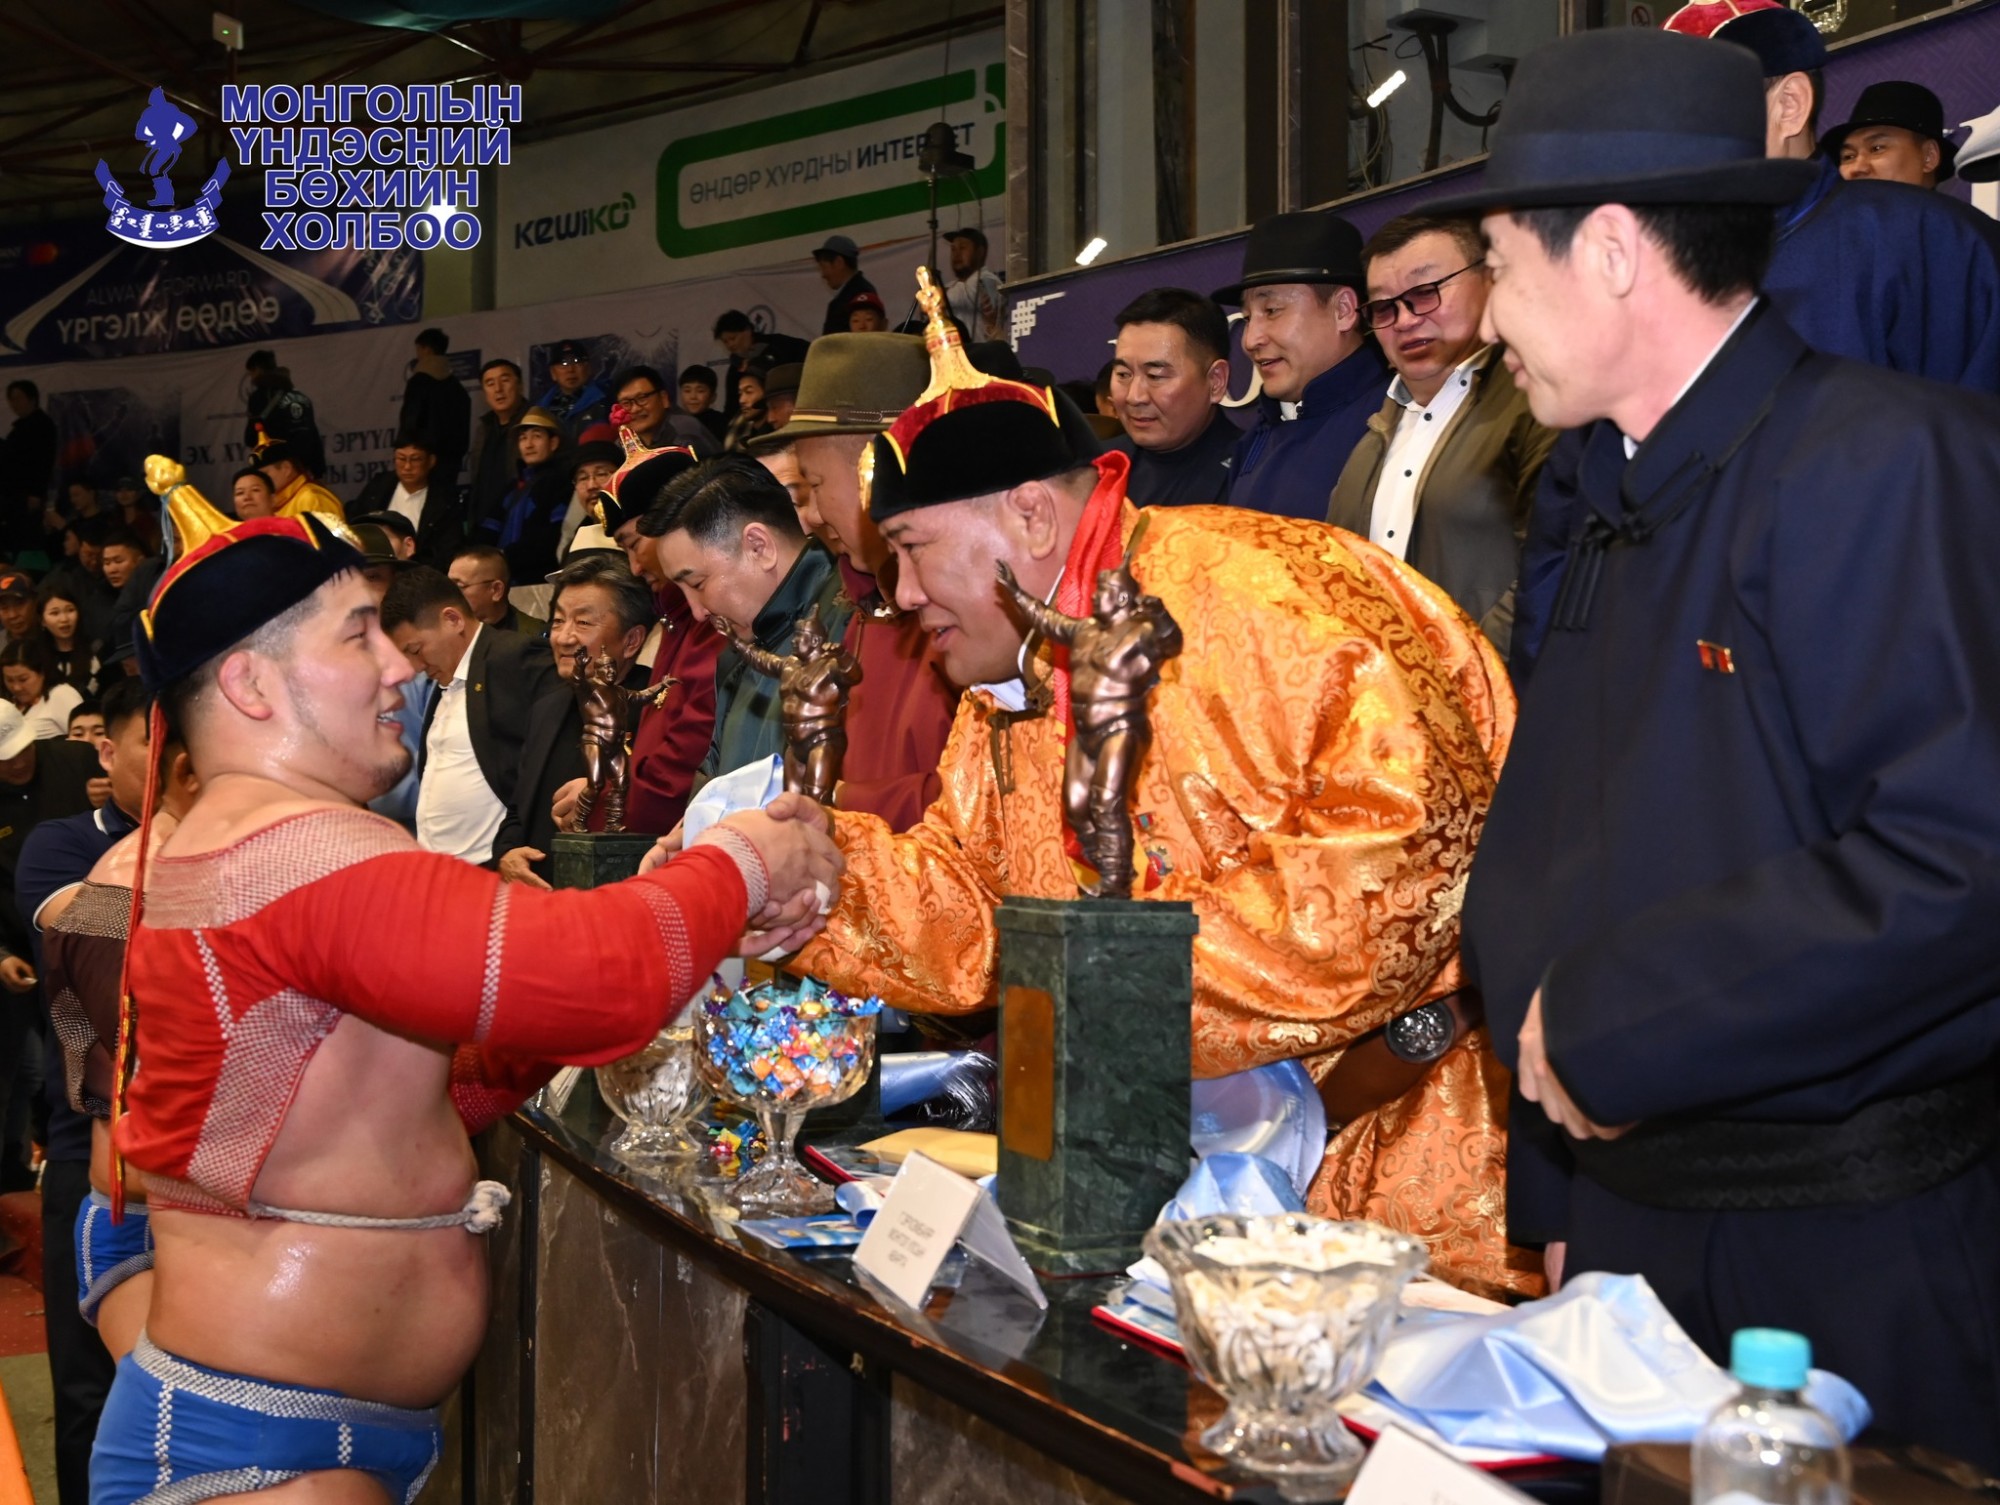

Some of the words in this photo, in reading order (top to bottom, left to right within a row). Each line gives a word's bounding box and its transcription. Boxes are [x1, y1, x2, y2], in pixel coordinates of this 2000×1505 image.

[690, 169, 761, 204] ӨНДӨР
[766, 153, 853, 189] ХУРДНЫ
[858, 122, 975, 169] ИНТЕРЕТ
[87, 278, 158, 305] ALWAY
[57, 308, 168, 344] ҮРГЭЛЖ
[176, 296, 281, 333] ӨӨДӨӨ
